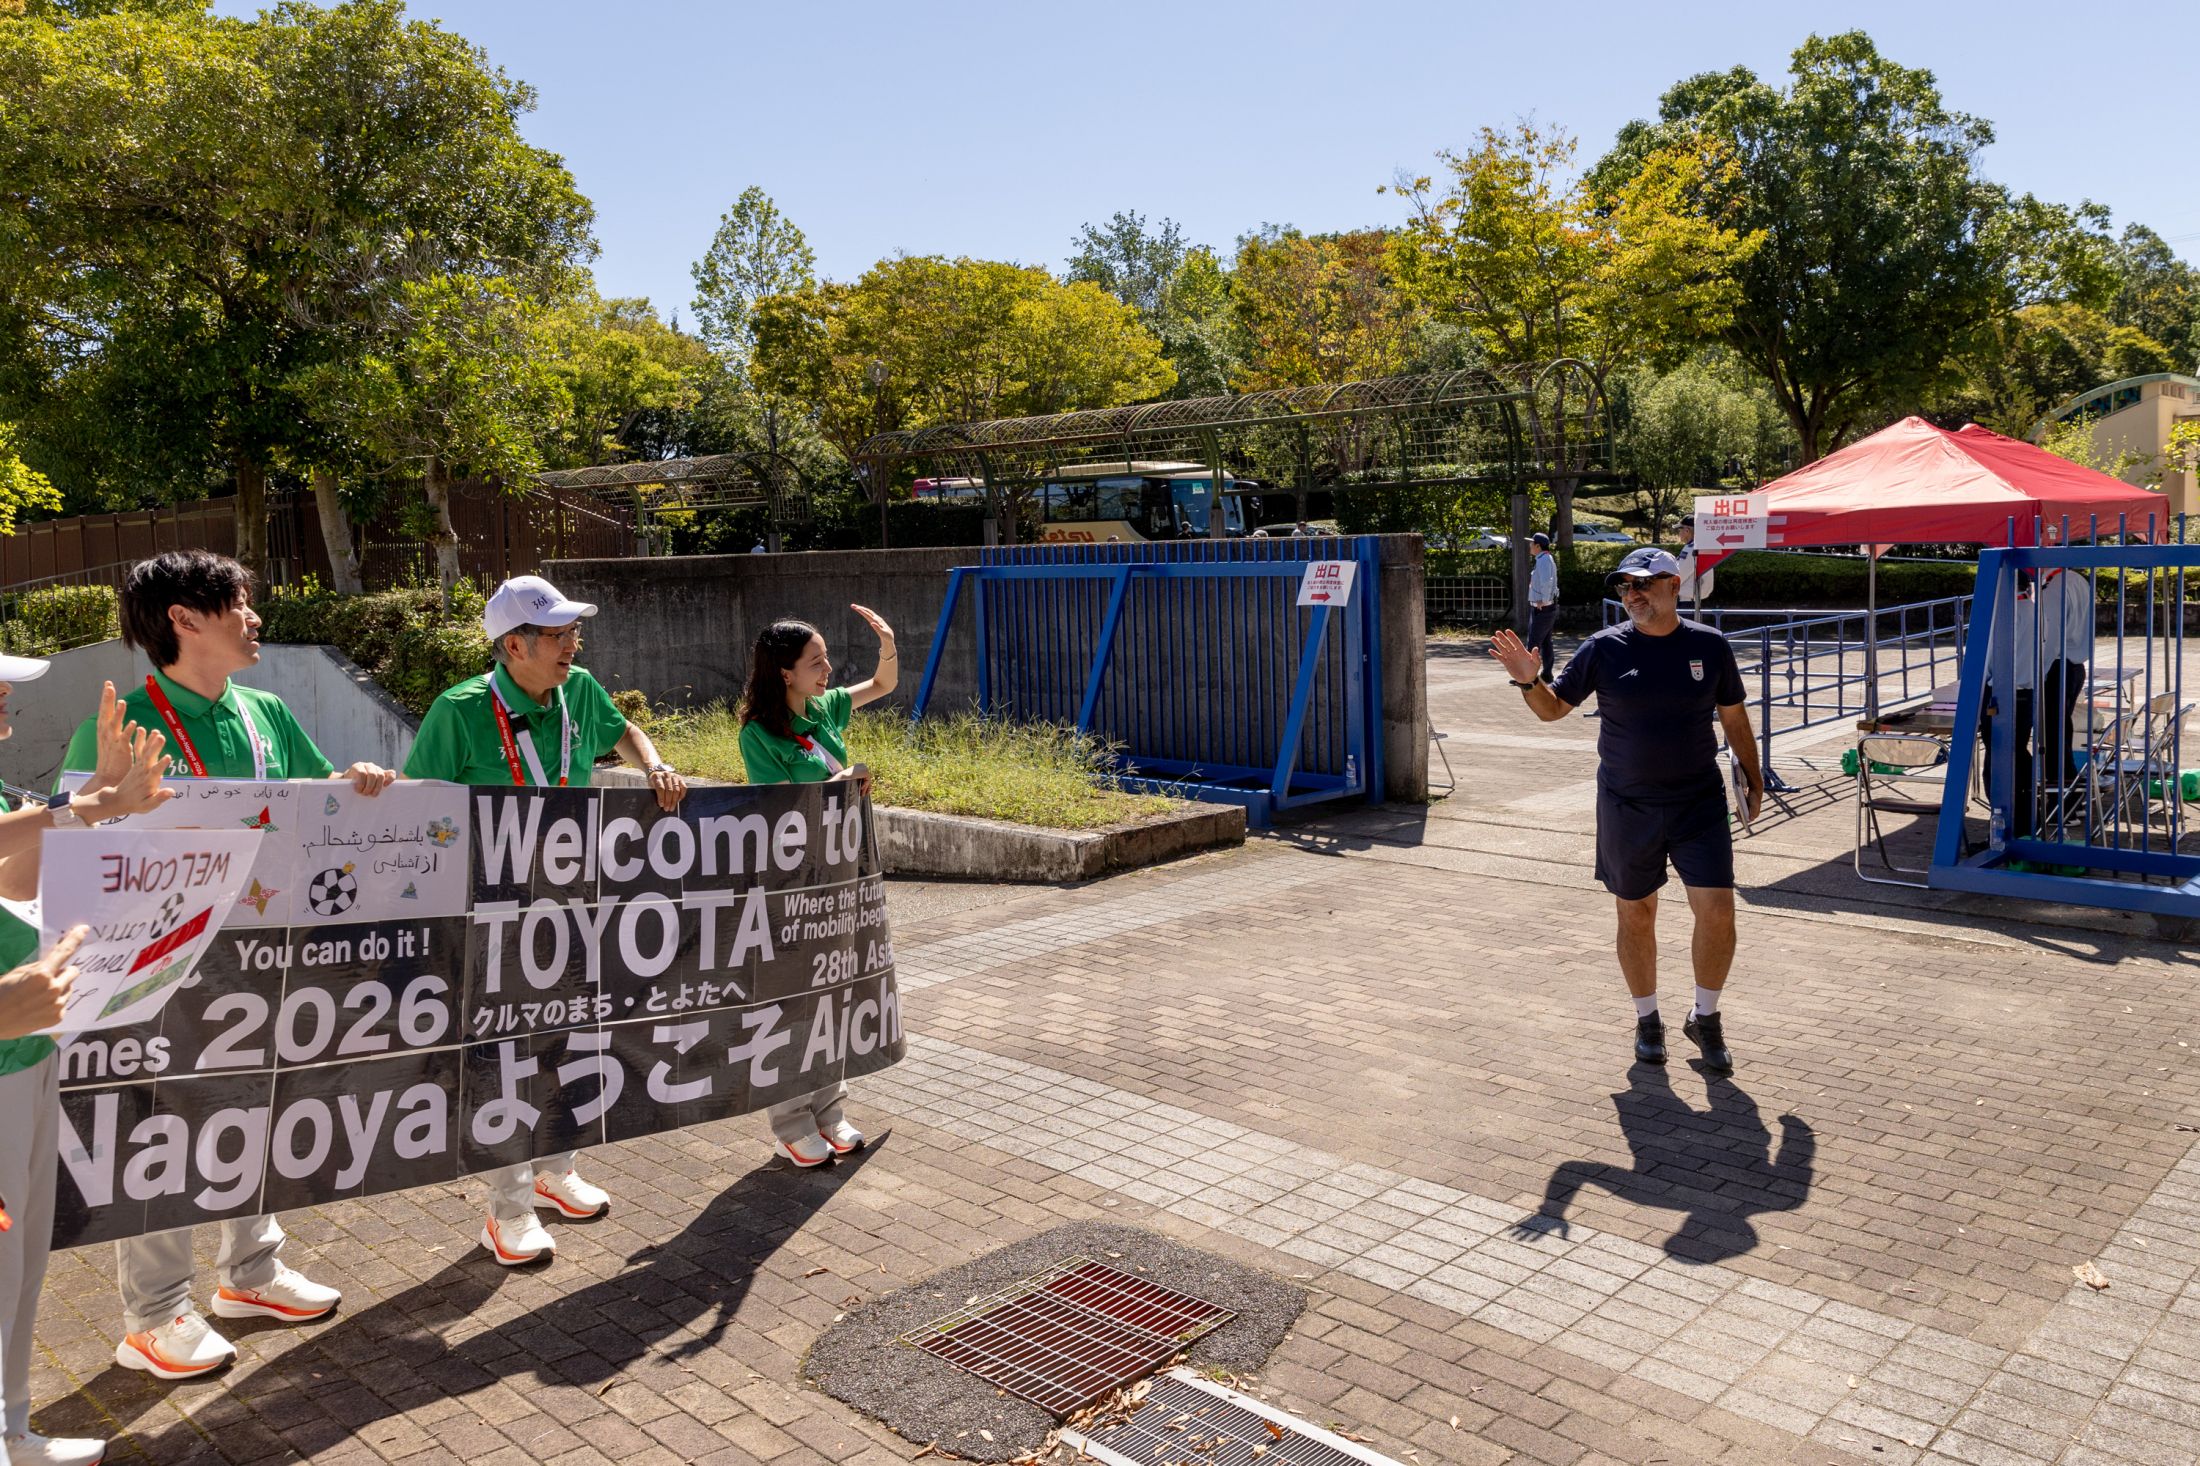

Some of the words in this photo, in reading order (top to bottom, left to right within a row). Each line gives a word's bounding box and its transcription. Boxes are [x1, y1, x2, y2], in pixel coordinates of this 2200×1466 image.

[1714, 499, 1748, 517] 出口
[1315, 564, 1341, 578] 出口
[476, 795, 808, 886] Welcome
[822, 796, 862, 866] to
[101, 852, 231, 893] WELCOME
[784, 893, 835, 918] Where
[838, 888, 856, 911] the
[235, 939, 294, 971] You
[301, 940, 351, 967] can
[359, 931, 390, 960] do
[474, 886, 775, 994] TOYOTA
[781, 918, 801, 944] of
[812, 946, 858, 988] 28th
[864, 936, 895, 973] Asia
[59, 1036, 171, 1080] mes
[194, 975, 449, 1070] 2026
[471, 1004, 791, 1146] ようこそ
[58, 1082, 447, 1211] Nagoya
